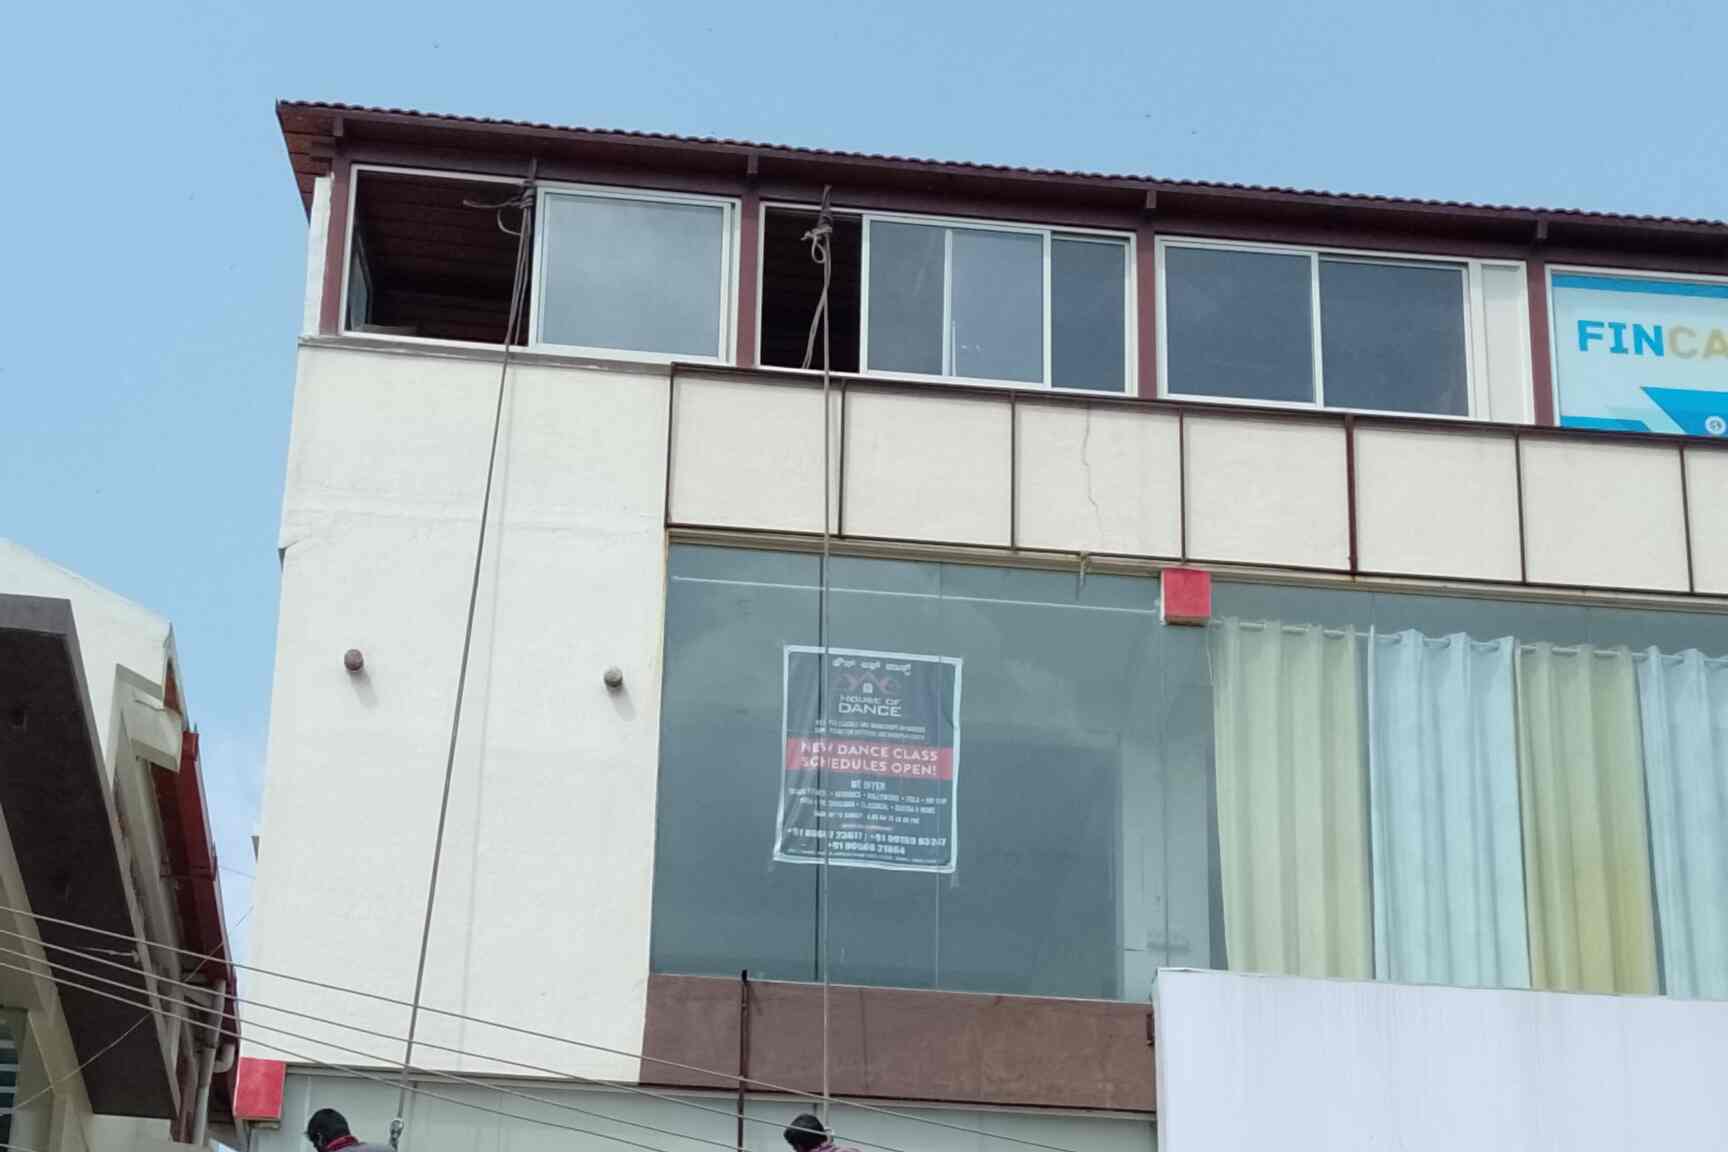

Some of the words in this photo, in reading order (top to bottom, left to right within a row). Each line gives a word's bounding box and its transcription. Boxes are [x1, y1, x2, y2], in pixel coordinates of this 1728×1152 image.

[838, 702, 902, 717] DANCE
[800, 740, 833, 753] NEW
[837, 744, 889, 758] DANCE
[893, 748, 939, 762] CLASS
[800, 756, 888, 771] SCHEDULES
[891, 763, 937, 777] OPEN!
